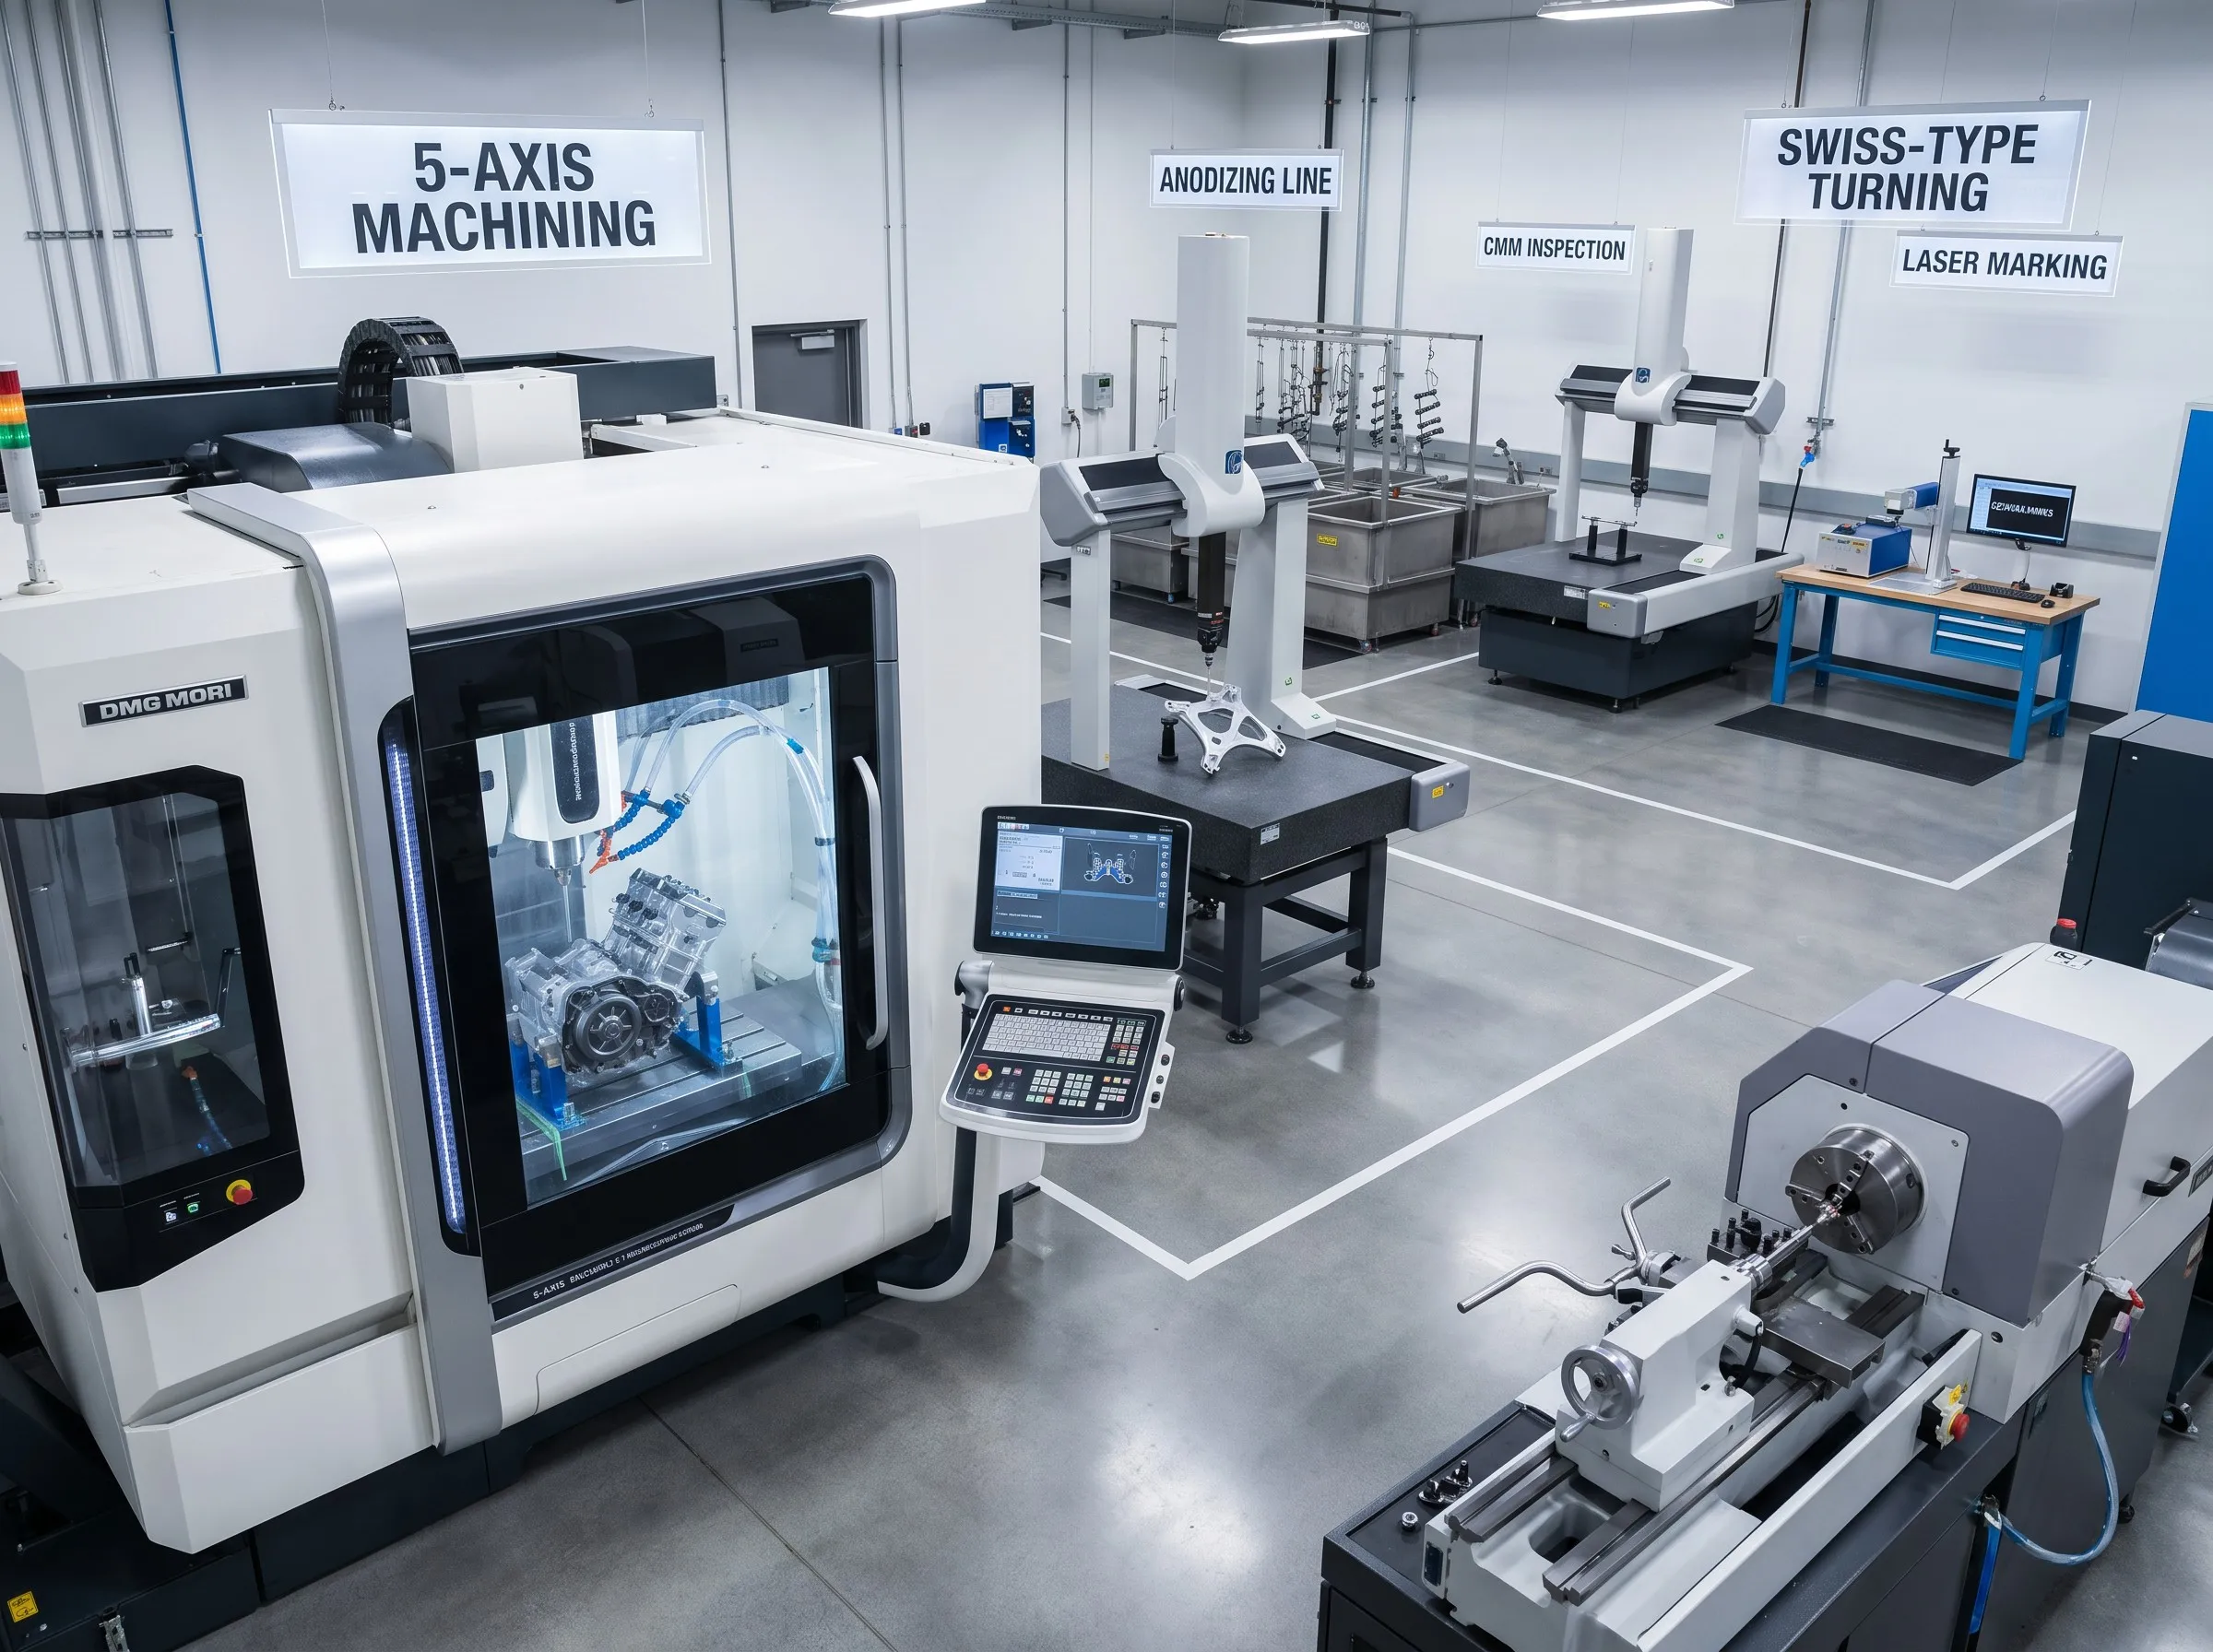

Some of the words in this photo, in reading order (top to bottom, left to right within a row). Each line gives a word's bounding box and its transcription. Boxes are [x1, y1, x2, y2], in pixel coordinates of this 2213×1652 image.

[1778, 124, 2039, 166] SWISS-TYPE
[414, 142, 594, 193] 5-AXIS
[1159, 166, 1275, 195] ANODIZING
[1283, 167, 1332, 195] LINE
[1808, 171, 1989, 212] TURNING
[352, 199, 656, 254] MACHINING
[1484, 236, 1522, 257] CMM
[1527, 238, 1626, 261] INSPECTION
[1902, 249, 1980, 275] LASER
[1986, 252, 2108, 280] MARKING
[99, 696, 161, 720] DMG
[165, 683, 231, 708] MORI
